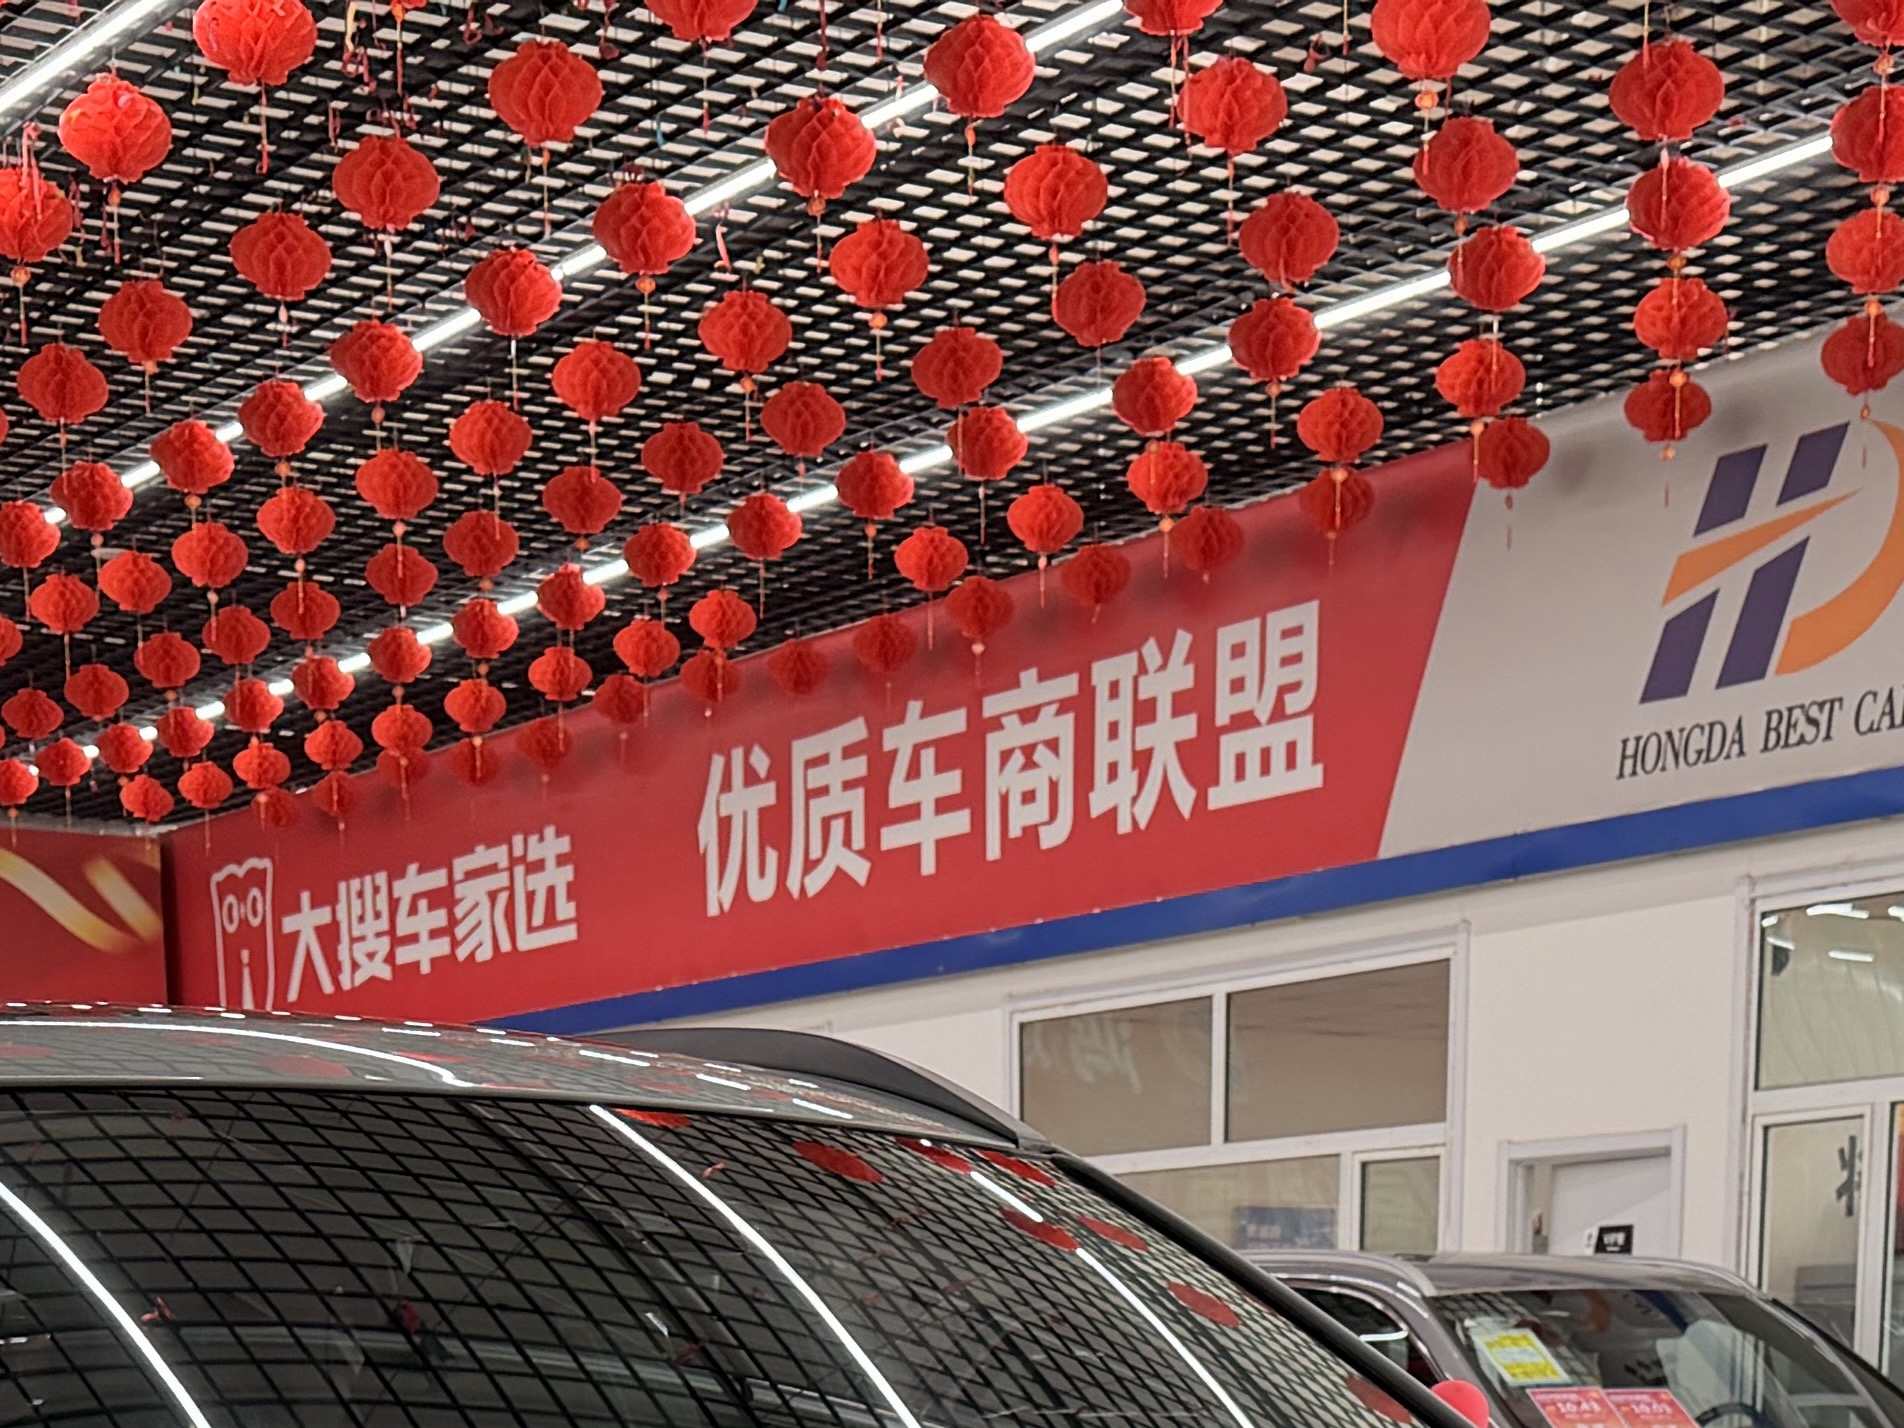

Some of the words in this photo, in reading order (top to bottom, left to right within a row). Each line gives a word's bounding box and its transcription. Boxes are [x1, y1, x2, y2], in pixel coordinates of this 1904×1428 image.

[697, 599, 1324, 917] 优质车商联盟
[1616, 715, 1747, 780] HONGDA
[1760, 697, 1844, 753] BEST
[280, 825, 578, 1002] 大搜车家选
